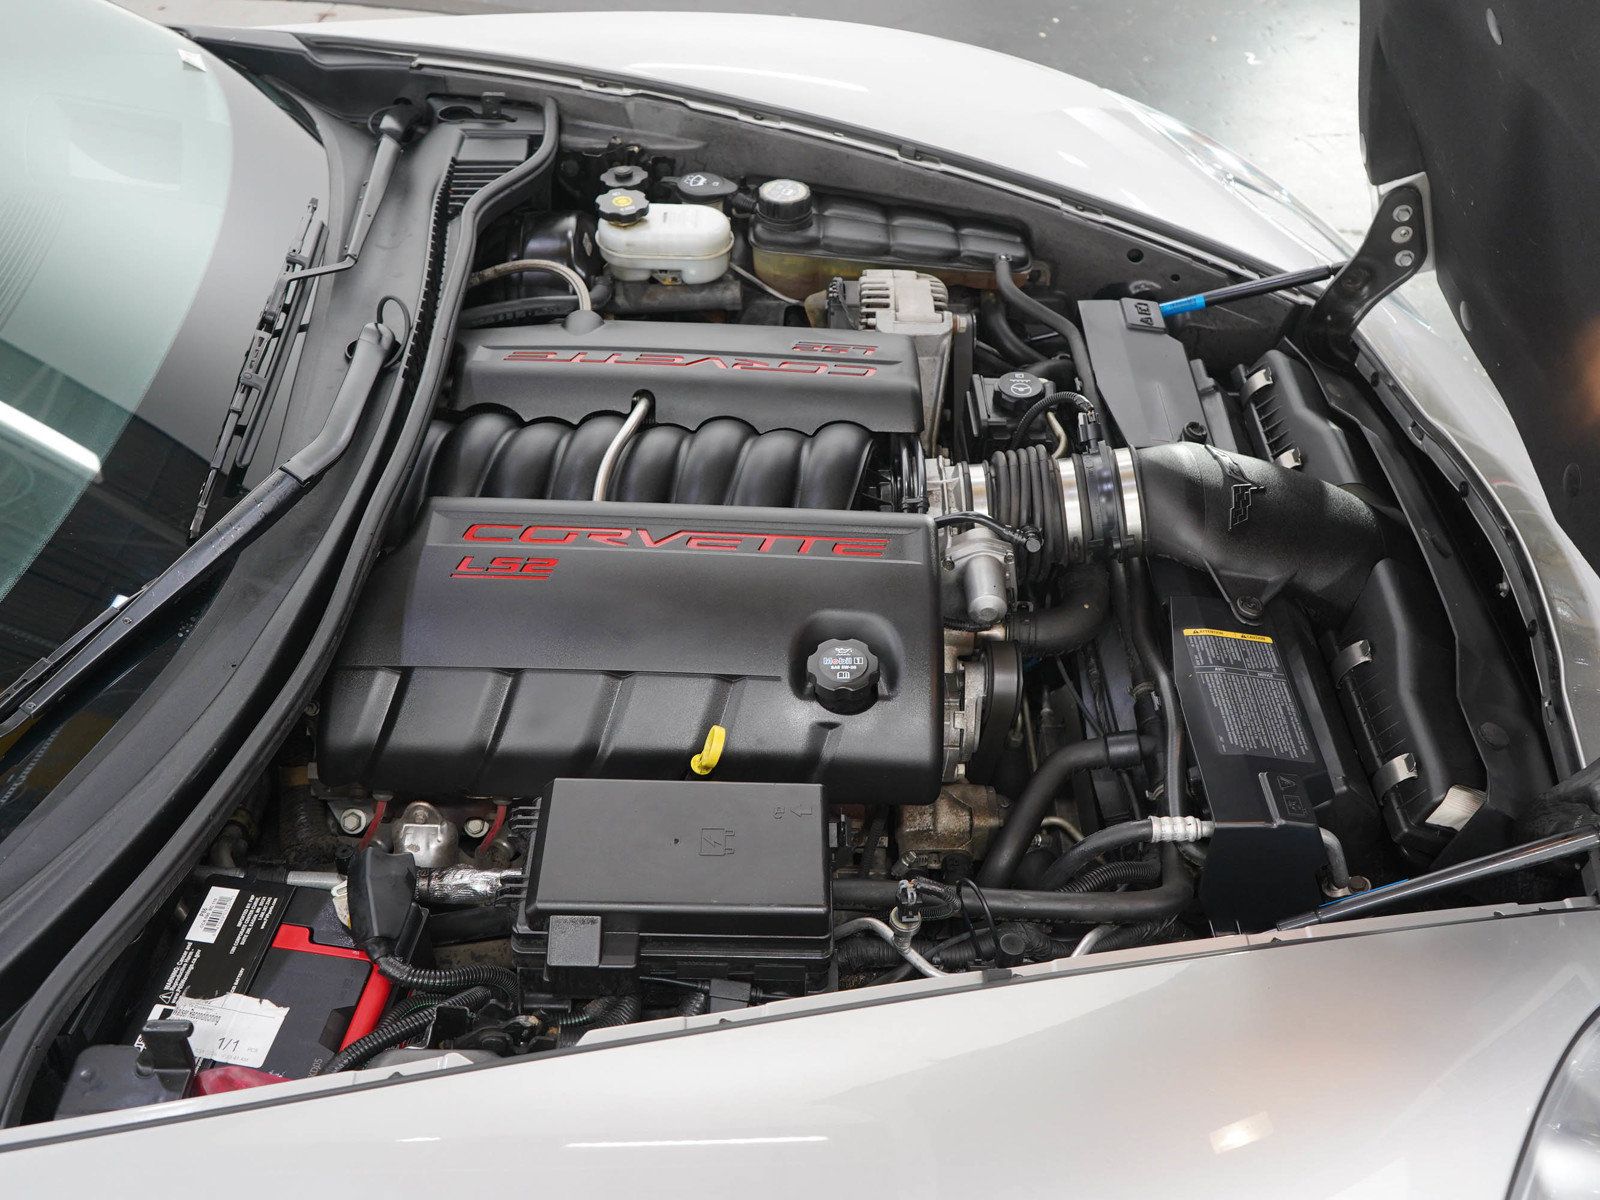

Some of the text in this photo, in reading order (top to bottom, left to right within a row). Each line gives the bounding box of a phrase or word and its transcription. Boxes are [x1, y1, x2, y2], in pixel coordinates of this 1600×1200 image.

[792, 341, 879, 355] LS2
[503, 351, 878, 376] CORVETTE
[463, 523, 890, 557] CORVETTE
[454, 556, 559, 576] LS2
[823, 657, 853, 665] Mobil
[218, 1037, 240, 1052] 1/1
